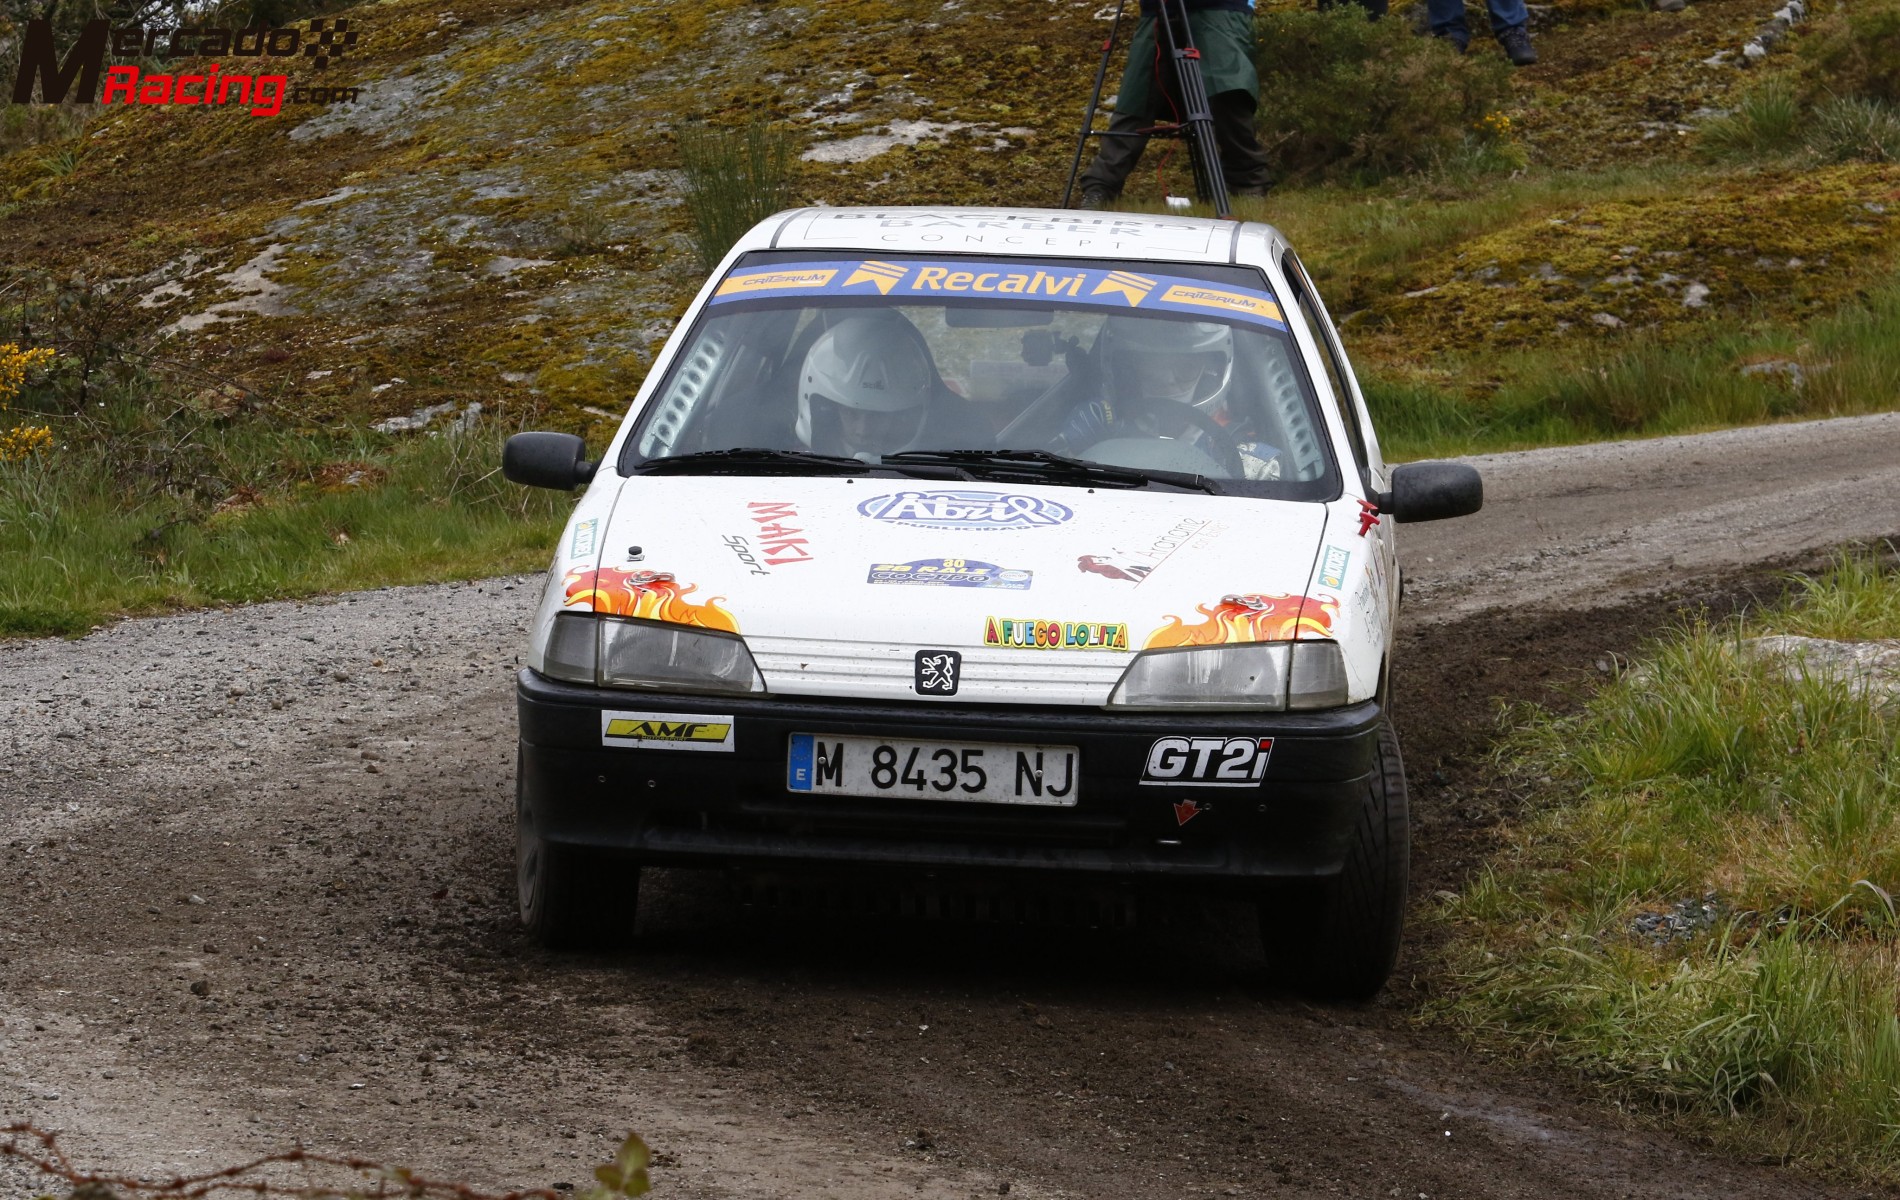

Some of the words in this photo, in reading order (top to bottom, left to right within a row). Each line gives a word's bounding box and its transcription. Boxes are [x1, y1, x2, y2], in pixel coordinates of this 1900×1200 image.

[879, 219, 1143, 237] BARBER
[881, 233, 1126, 250] CONCEPT
[912, 266, 1087, 296] Recalvi
[747, 502, 814, 565] MAKI
[895, 521, 1032, 532] PUBLICIDAD
[721, 534, 771, 576] Sport
[872, 572, 991, 583] COCIDO
[986, 617, 1000, 644] A
[1002, 620, 1061, 647] FUEGO
[1066, 623, 1126, 649] LOLITA
[626, 721, 708, 738] AMF
[816, 742, 844, 787] M
[871, 745, 987, 794] 8435
[1015, 751, 1074, 797] NJ
[1147, 738, 1272, 779] GT2i
[796, 768, 806, 781] E
